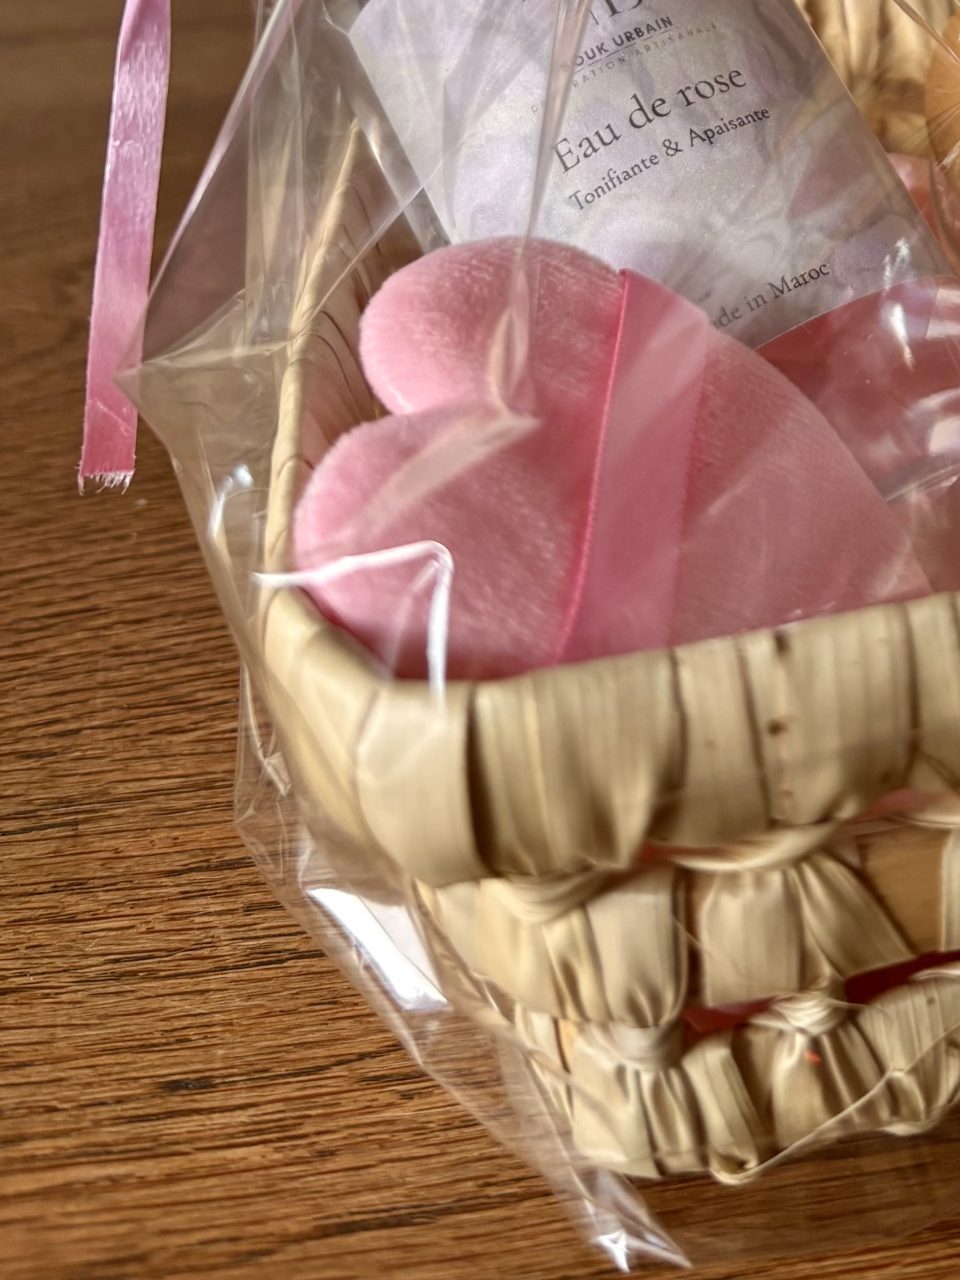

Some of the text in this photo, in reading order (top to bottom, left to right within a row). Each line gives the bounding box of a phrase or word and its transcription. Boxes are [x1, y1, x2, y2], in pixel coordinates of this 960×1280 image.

[613, 16, 674, 48] URBAIN
[554, 70, 747, 175] Eau de rose
[568, 107, 772, 211] Tonifiante & Apaisante
[710, 263, 831, 330] de in Maroc
